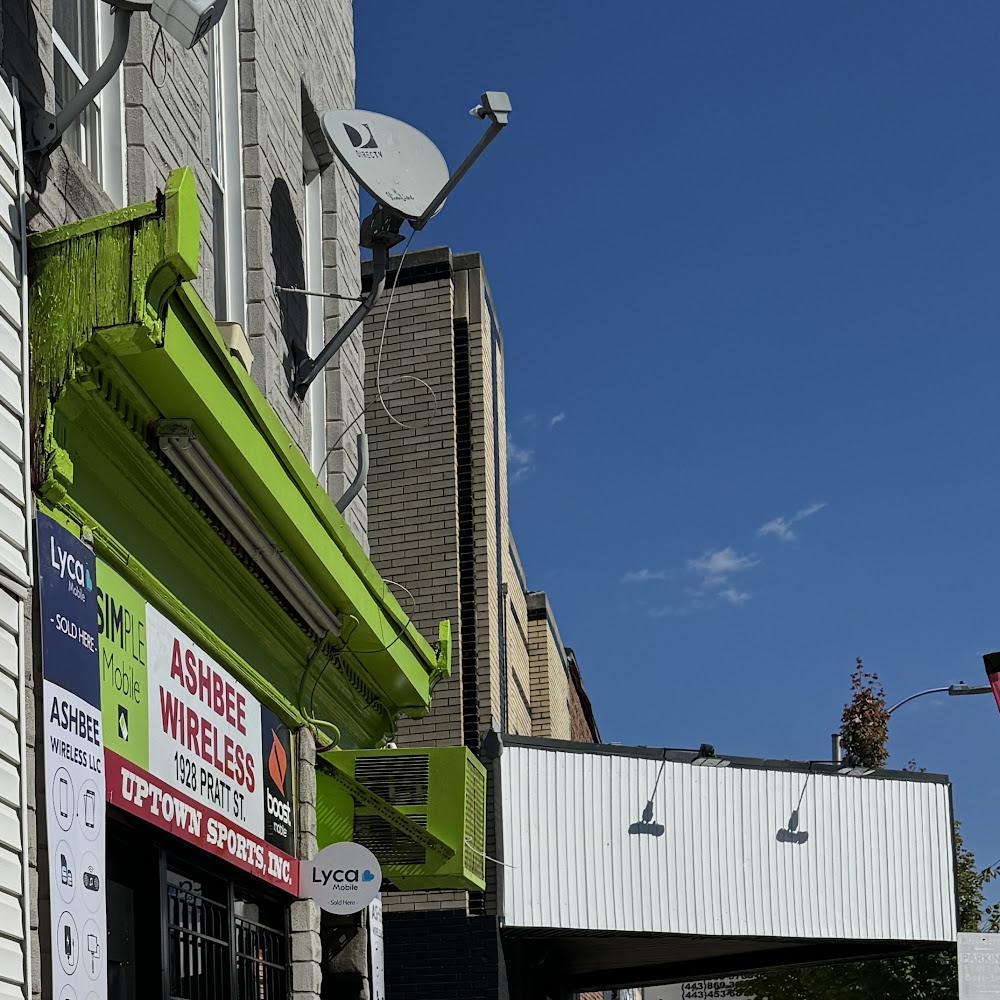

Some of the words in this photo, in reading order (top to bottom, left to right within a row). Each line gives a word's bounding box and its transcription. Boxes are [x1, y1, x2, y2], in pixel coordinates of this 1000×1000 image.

[50, 536, 85, 588] Lyca
[68, 580, 86, 603] Mobile
[56, 613, 77, 639] SOLD
[79, 627, 95, 653] HERE
[96, 586, 146, 667] SIMPLE
[102, 647, 141, 704] Mobile
[170, 637, 247, 737] ASHBEE
[50, 696, 100, 747] ASHBEE
[159, 684, 256, 794] WIRELESS
[50, 735, 87, 767] WIRELESS
[88, 753, 102, 774] LLC
[174, 750, 197, 792] 1928
[200, 767, 232, 813] PRATT
[233, 789, 246, 822] ST.
[266, 787, 292, 827] boost
[120, 766, 202, 838] UPTOWN
[206, 817, 267, 875] SPORTS,
[267, 850, 293, 885] INC.
[273, 821, 288, 838] mobile
[312, 866, 359, 886] Lyca
